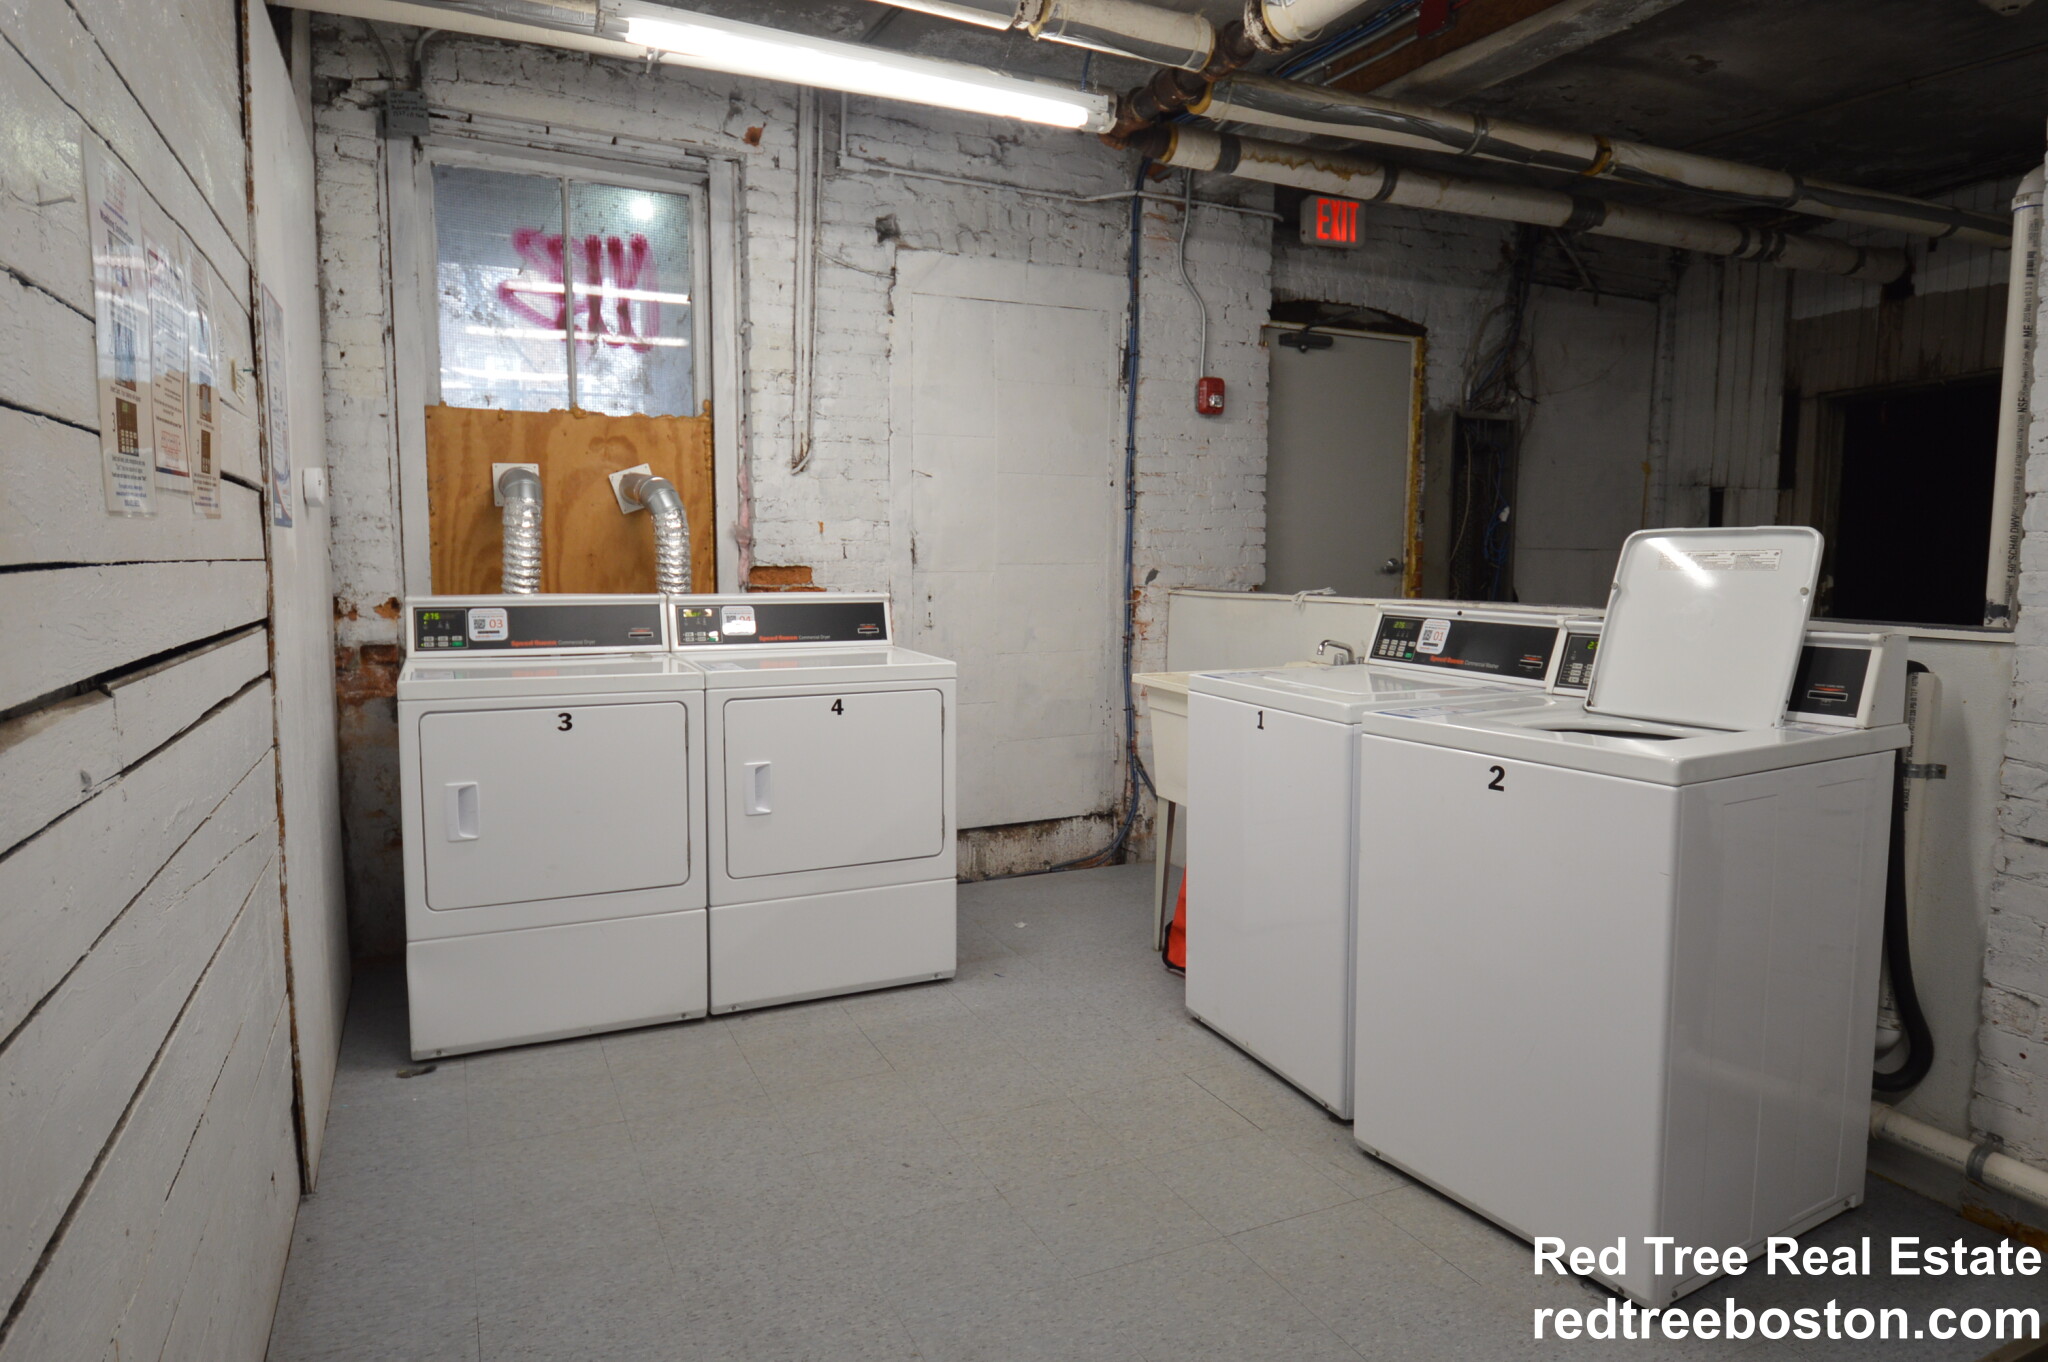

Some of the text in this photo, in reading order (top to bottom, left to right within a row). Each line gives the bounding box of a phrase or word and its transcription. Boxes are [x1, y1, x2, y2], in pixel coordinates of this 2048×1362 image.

[1316, 198, 1359, 243] EXIT
[2009, 514, 2020, 533] DWV
[2017, 397, 2028, 413] NSF
[489, 619, 503, 629] 03
[1433, 631, 1444, 641] 01
[831, 699, 844, 715] 4
[557, 712, 573, 731] 3
[1256, 710, 1265, 731] 1
[1488, 765, 1506, 792] 2
